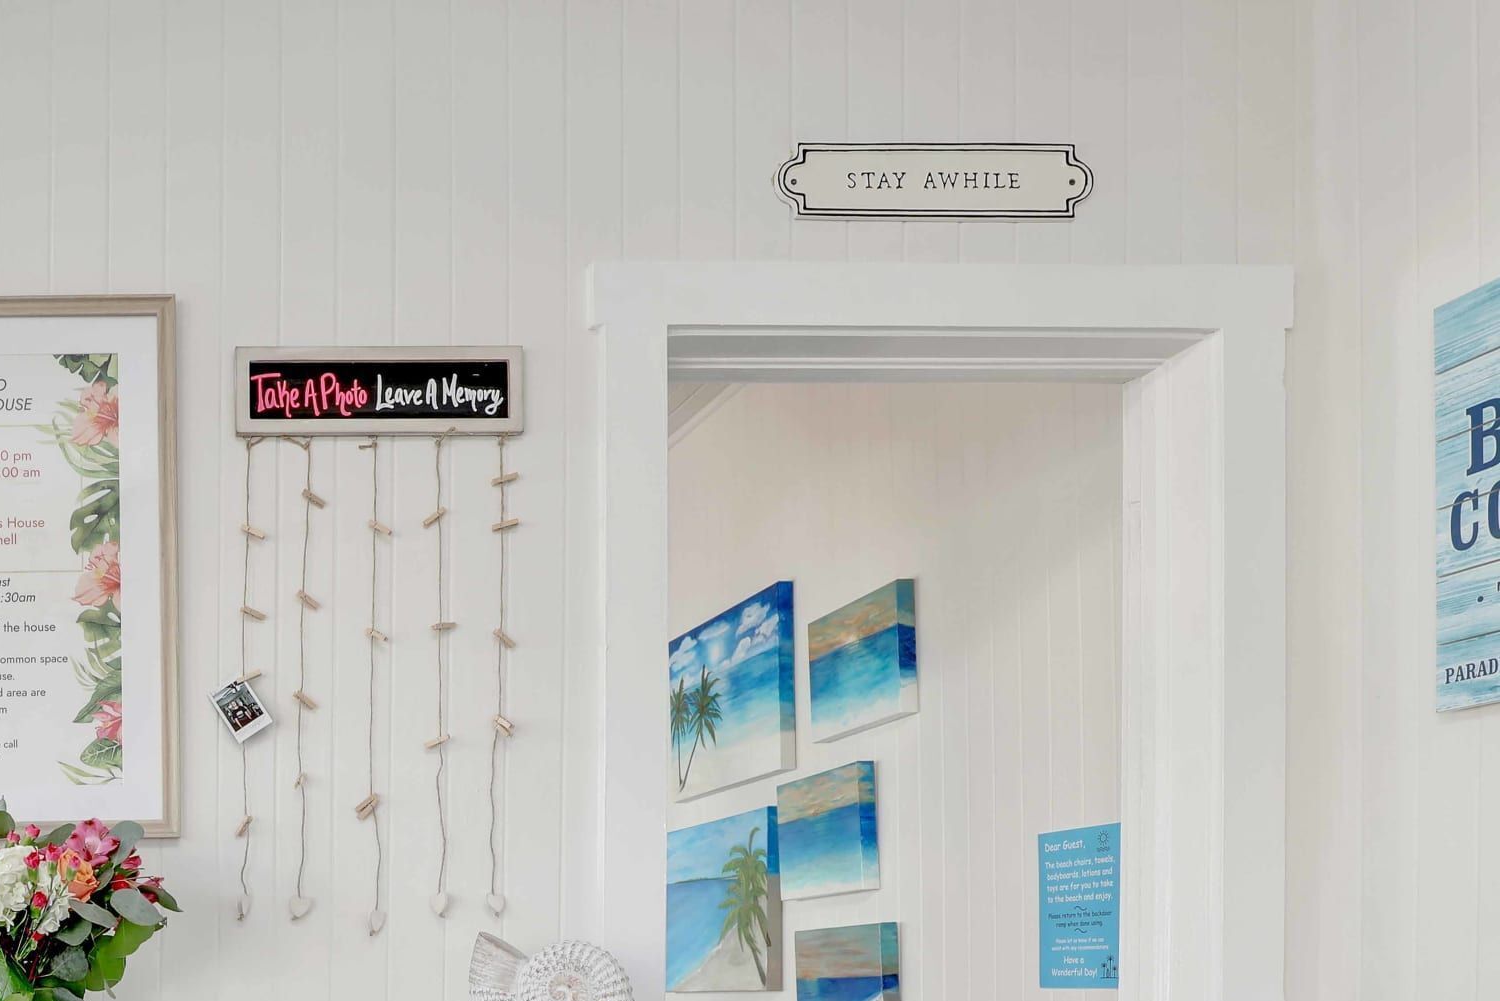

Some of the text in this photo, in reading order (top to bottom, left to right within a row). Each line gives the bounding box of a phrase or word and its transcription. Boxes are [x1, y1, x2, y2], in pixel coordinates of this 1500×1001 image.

[847, 172, 1021, 189] STAY AWHILE
[250, 373, 300, 418] Take
[304, 379, 320, 416] A
[320, 372, 368, 416] Photo
[375, 374, 423, 411] Leave
[425, 378, 438, 410] A
[13, 453, 32, 464] pm
[23, 469, 41, 478] am
[7, 516, 45, 529] House
[4, 621, 20, 633] the
[24, 621, 56, 633] house
[40, 656, 68, 666] space
[6, 690, 28, 698] area
[3, 739, 18, 749] call
[1044, 843, 1060, 852] Dear
[1056, 859, 1072, 867] beach
[1081, 868, 1100, 877] lotions
[1102, 866, 1113, 875] and
[1047, 885, 1058, 893] toys
[1070, 881, 1080, 890] for
[1081, 883, 1091, 893] you
[1100, 879, 1113, 888] take
[1054, 895, 1064, 903] the
[1064, 893, 1082, 902] beach
[1083, 892, 1094, 901] and
[1063, 956, 1079, 964] Have
[1051, 968, 1082, 977] Wonderful
